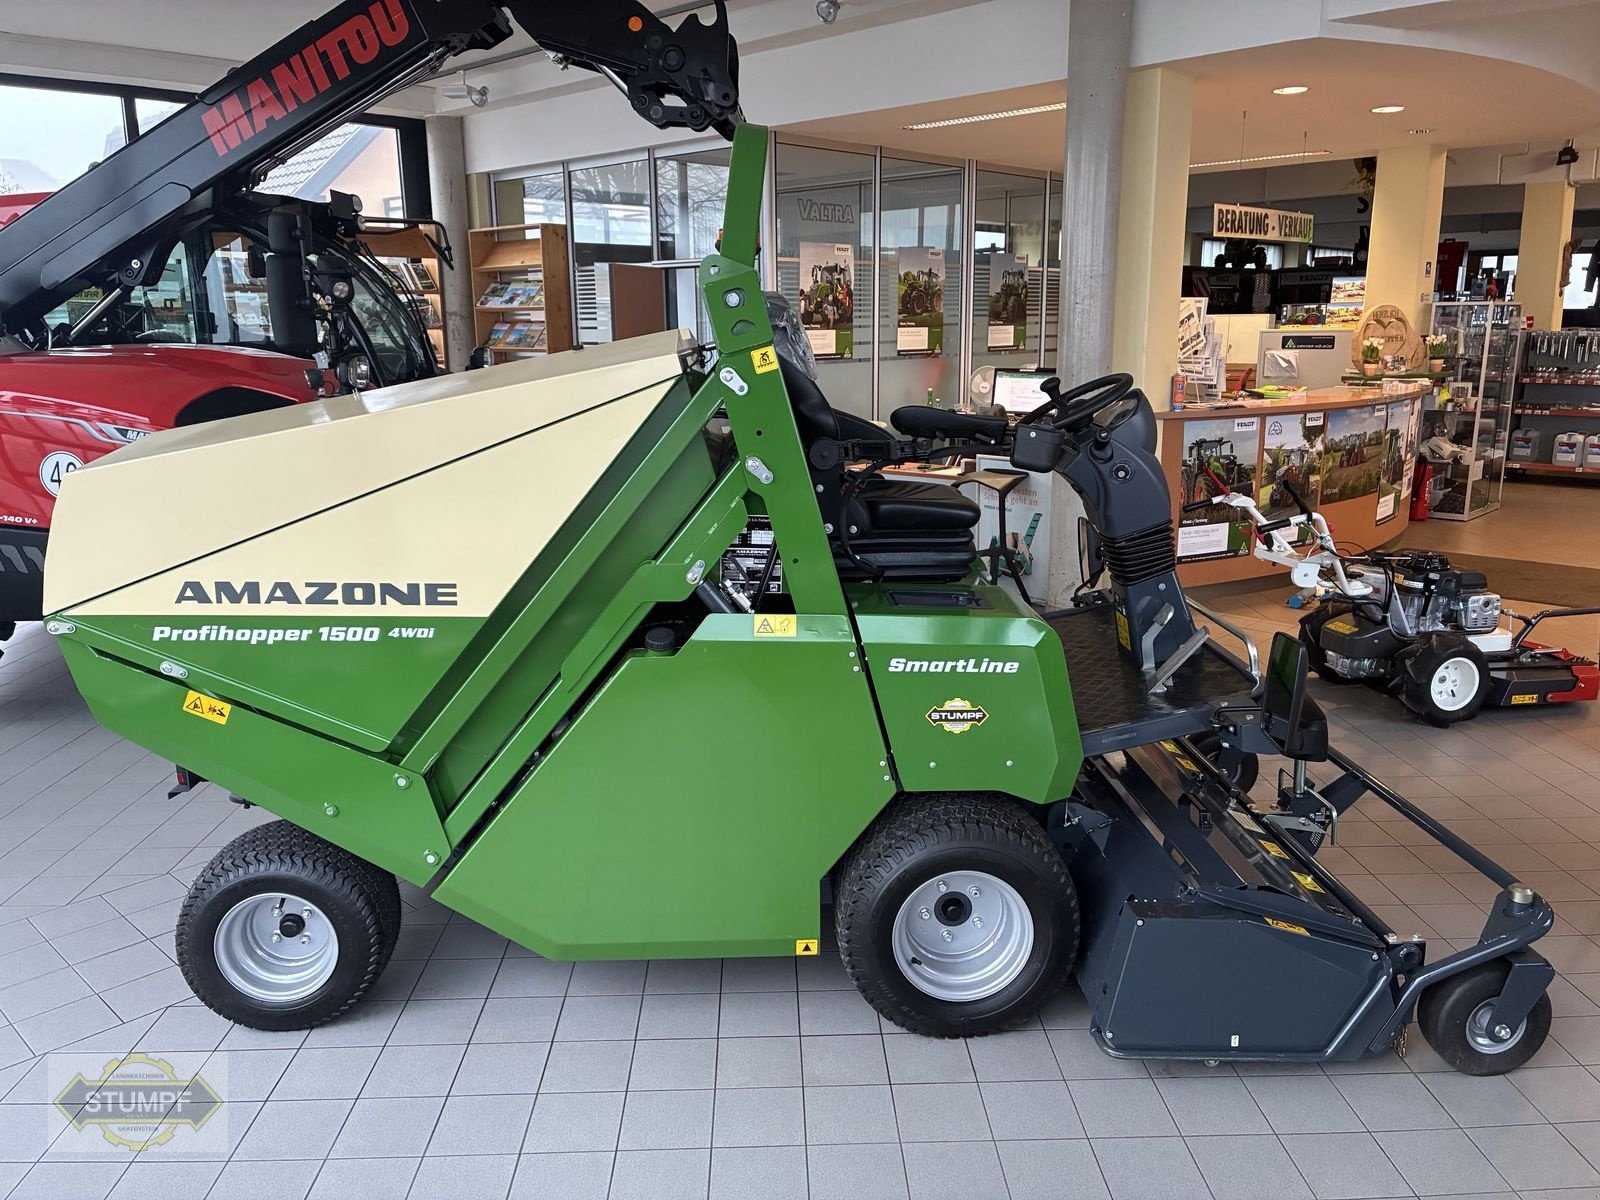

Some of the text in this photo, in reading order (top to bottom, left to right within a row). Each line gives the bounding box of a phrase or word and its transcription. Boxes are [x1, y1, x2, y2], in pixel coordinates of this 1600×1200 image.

[201, 0, 409, 157] MANITOU
[798, 198, 854, 224] VALTRA
[1217, 208, 1269, 236] BERATUNG
[1277, 214, 1312, 240] VERKAUF
[1373, 309, 1399, 319] HERZLICH
[174, 580, 458, 606] AMAZONE
[152, 624, 435, 645] Profihopper 1500 4WDi
[888, 657, 1020, 674] SmartLine
[930, 711, 984, 720] STUMPF
